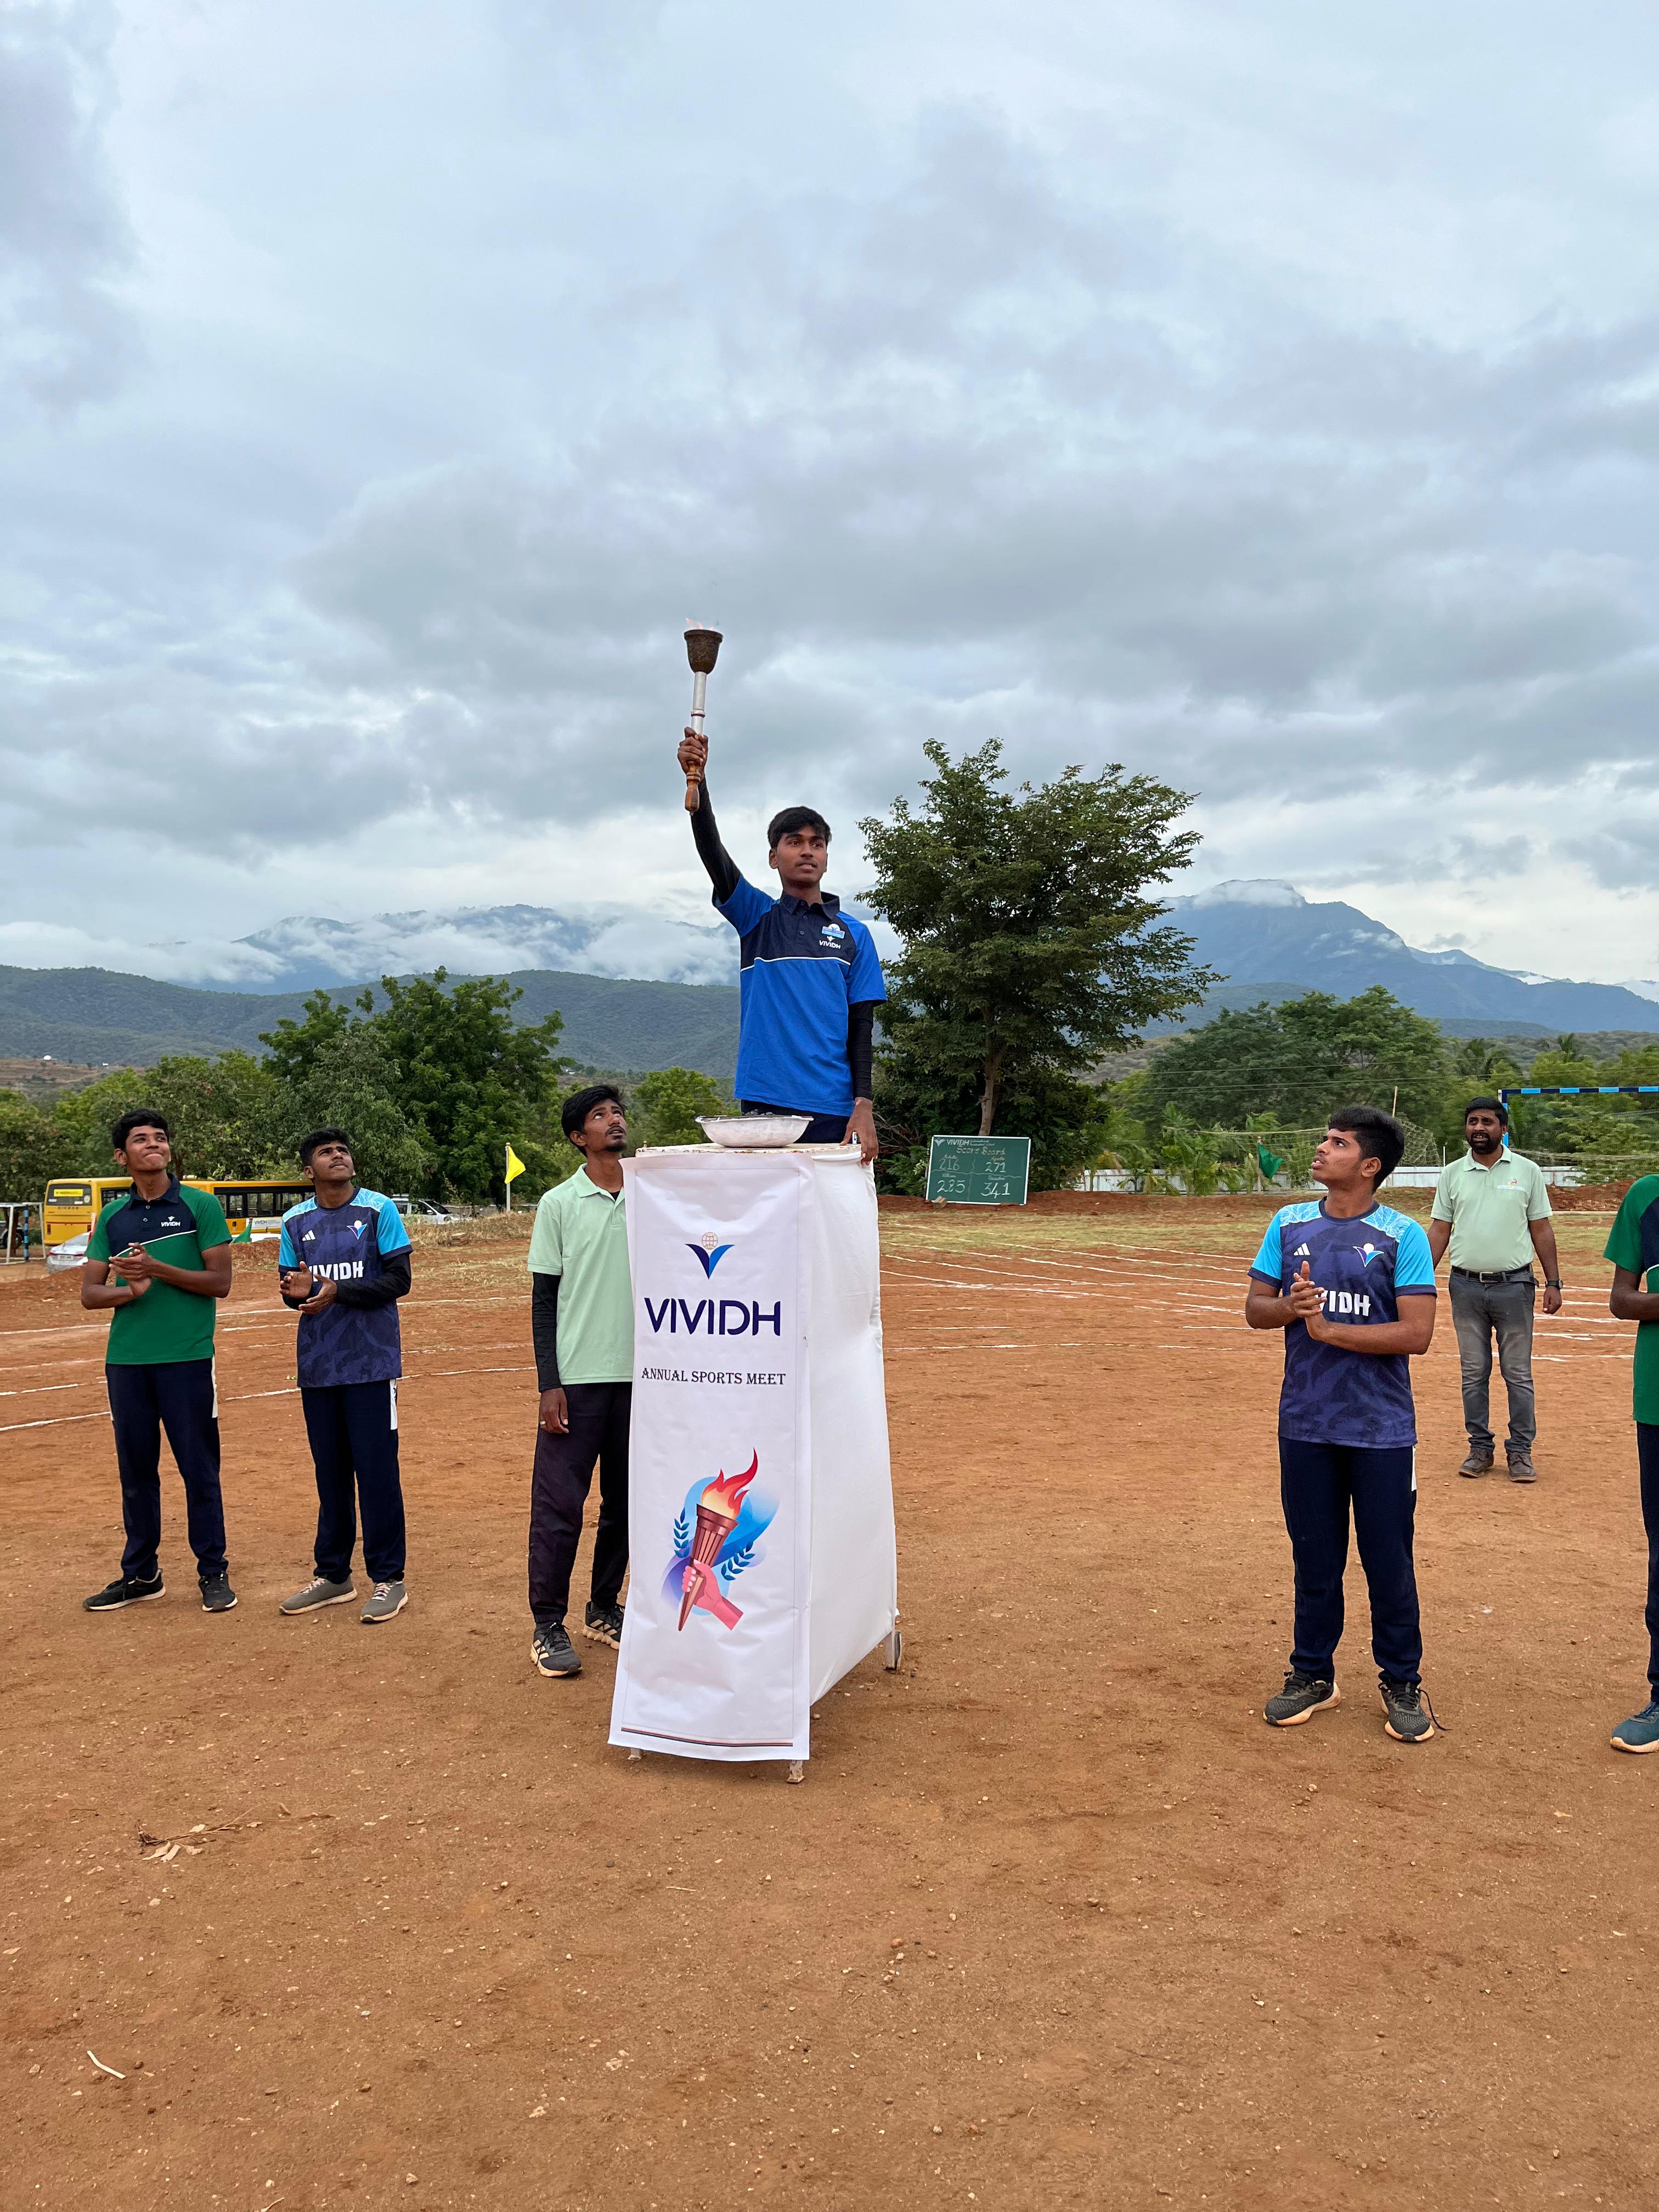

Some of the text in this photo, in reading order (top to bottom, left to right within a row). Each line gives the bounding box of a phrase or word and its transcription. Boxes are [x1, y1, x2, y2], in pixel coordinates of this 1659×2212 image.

[819, 940, 840, 949] VIVIDH
[939, 1158, 960, 1170] 216
[985, 1162, 1006, 1172] 271
[980, 1182, 1011, 1199] 341
[644, 1297, 781, 1336] VIVIDH
[641, 1367, 786, 1385] ANNUAL SPORTS MEET
